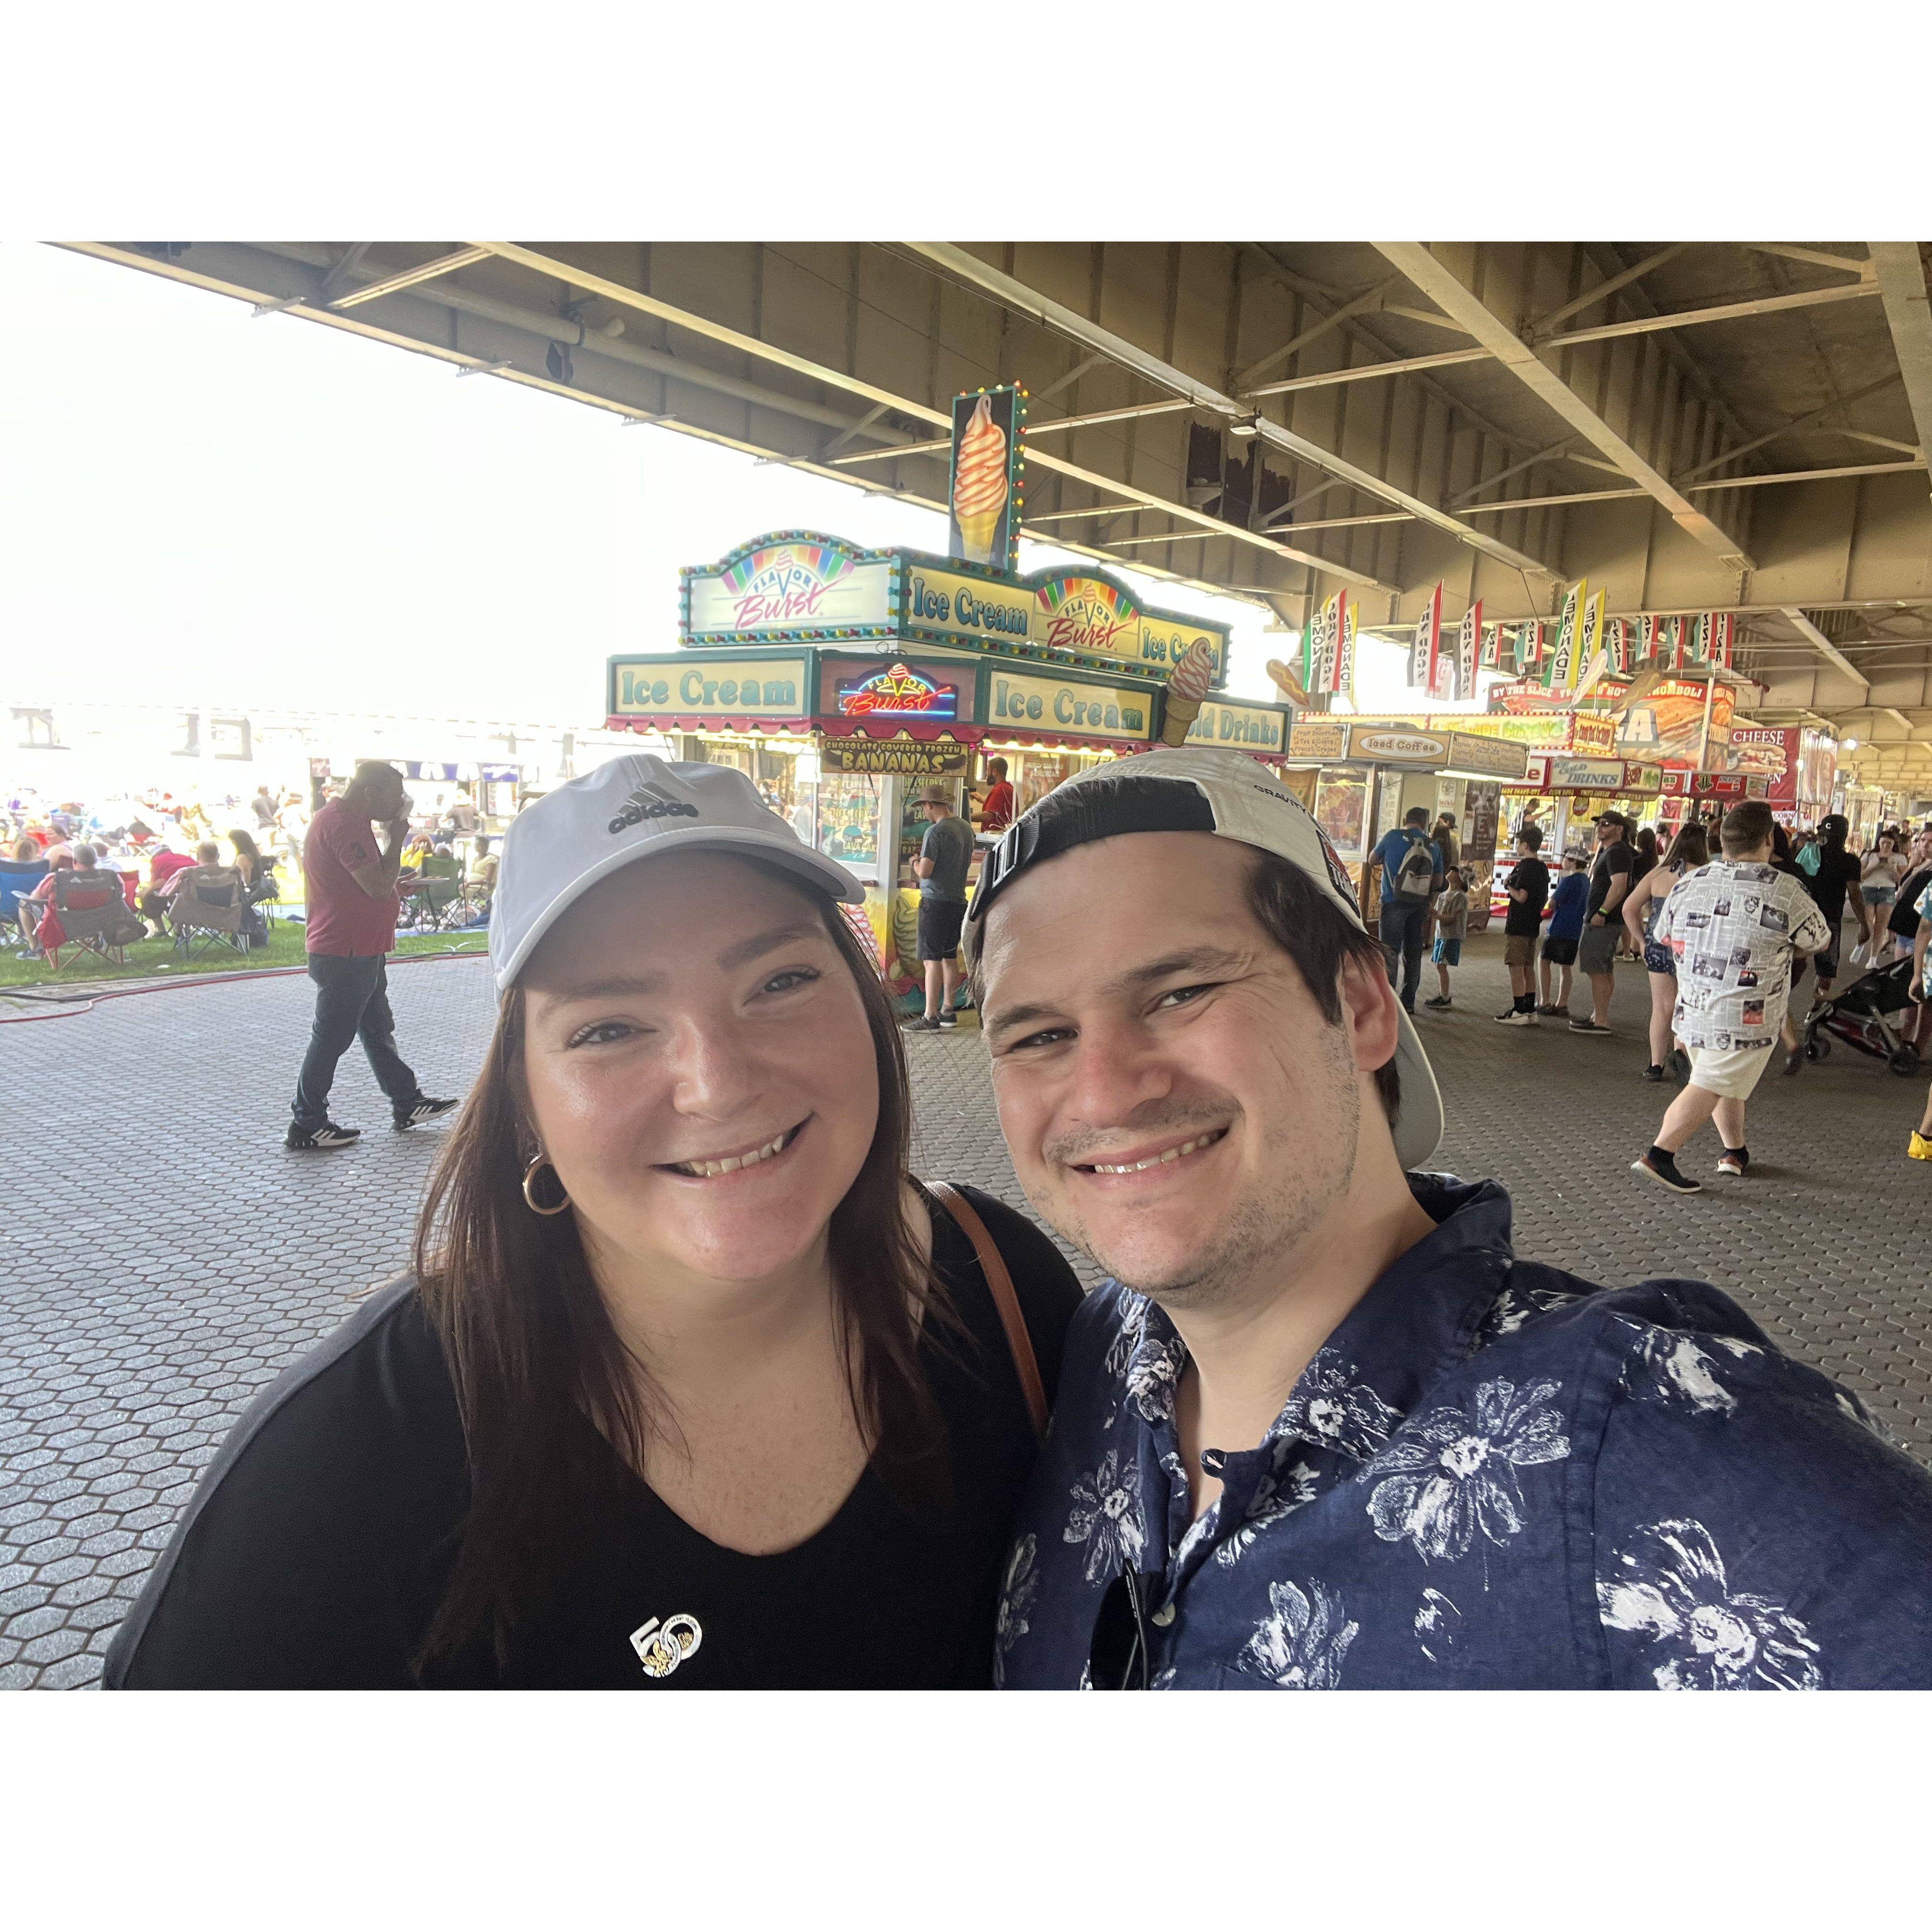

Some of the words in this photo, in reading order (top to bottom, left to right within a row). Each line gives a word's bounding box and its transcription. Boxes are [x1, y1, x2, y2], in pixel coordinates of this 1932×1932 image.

[753, 568, 811, 599] FLAVOR
[734, 576, 845, 630] Burst
[913, 577, 949, 621] Ice
[954, 587, 1027, 636] Cream
[1064, 599, 1110, 627] FLAVOR
[1047, 618, 1134, 648] Burst
[1142, 627, 1167, 661] Ice
[1170, 633, 1219, 671] Crm
[622, 671, 669, 705] Ice
[679, 670, 796, 706] Cream
[843, 686, 951, 715] Burst
[868, 676, 927, 697] FLAVOR
[1493, 687, 1505, 698] BY
[1507, 685, 1525, 695] THE
[1527, 685, 1553, 698] SLICE
[995, 680, 1043, 720] Ice
[1054, 689, 1143, 731] Cream
[1219, 710, 1278, 746] Drinks
[1733, 730, 1785, 746] CHEESE
[825, 740, 878, 751] CHOCOLATE
[880, 742, 921, 752] COVERED
[925, 743, 961, 754] FROZEN
[1368, 738, 1393, 749] Iced
[1397, 740, 1435, 751] Coffee
[841, 751, 944, 773] BANANAS
[1567, 773, 1619, 784] DRINKS
[1254, 784, 1306, 814] GRAVITY
[608, 803, 699, 834] adidas
